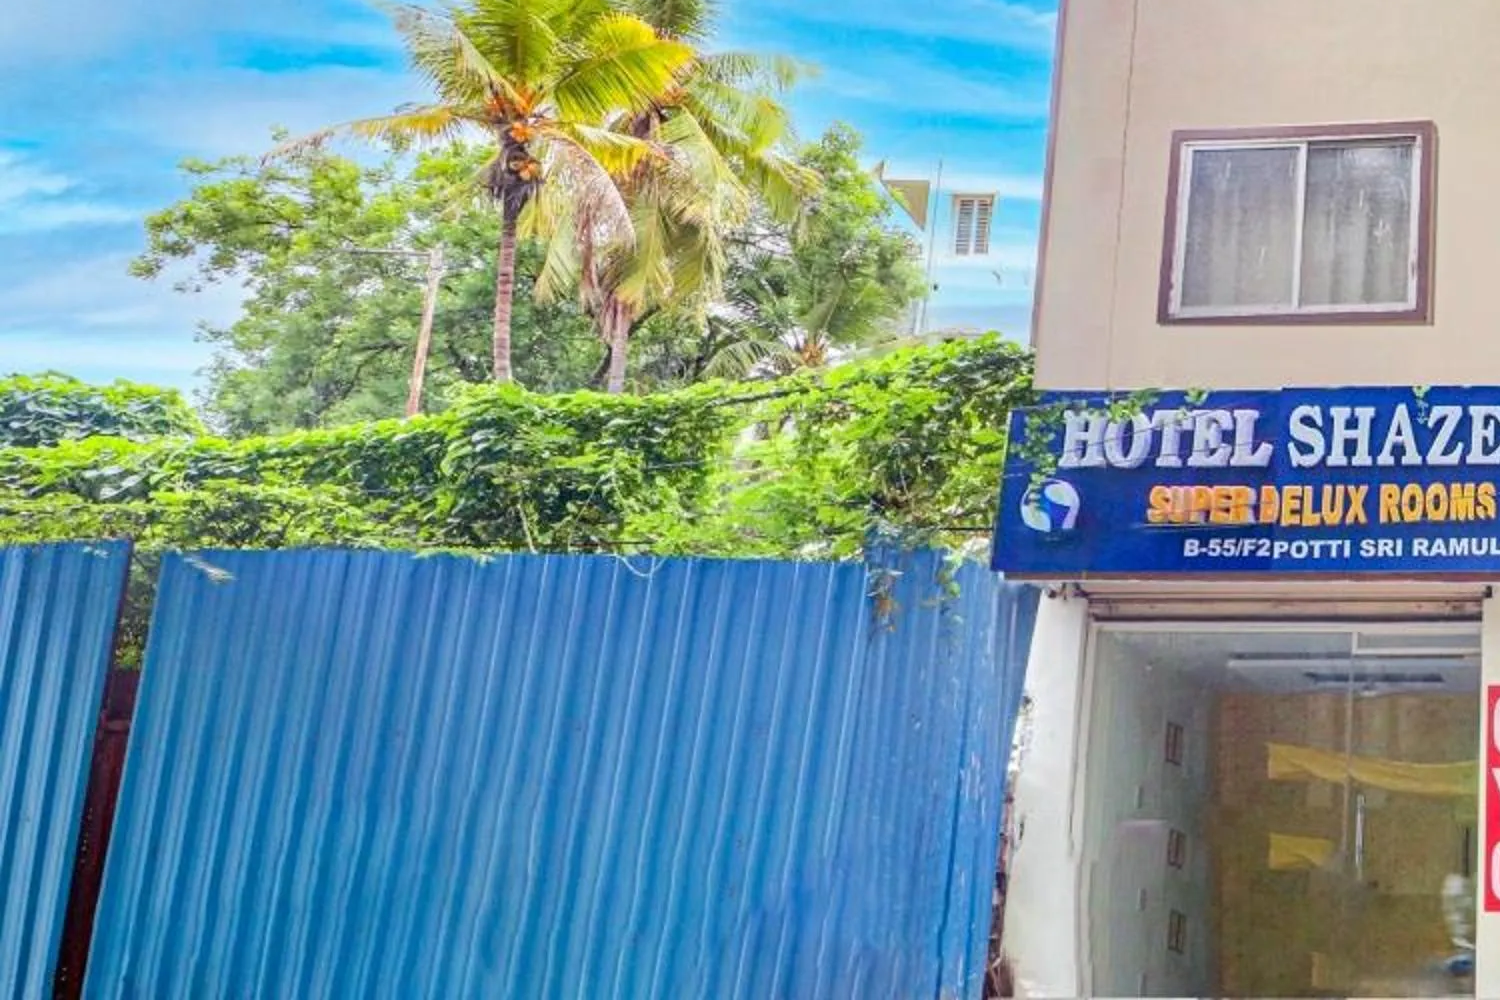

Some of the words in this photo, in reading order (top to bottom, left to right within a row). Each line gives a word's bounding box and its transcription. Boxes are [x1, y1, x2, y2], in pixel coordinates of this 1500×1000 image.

[1058, 408, 1273, 468] HOTEL
[1147, 485, 1255, 524] SUPER
[1260, 483, 1367, 526] DELUX
[1380, 481, 1497, 524] ROOMS
[1360, 539, 1402, 557] SRI
